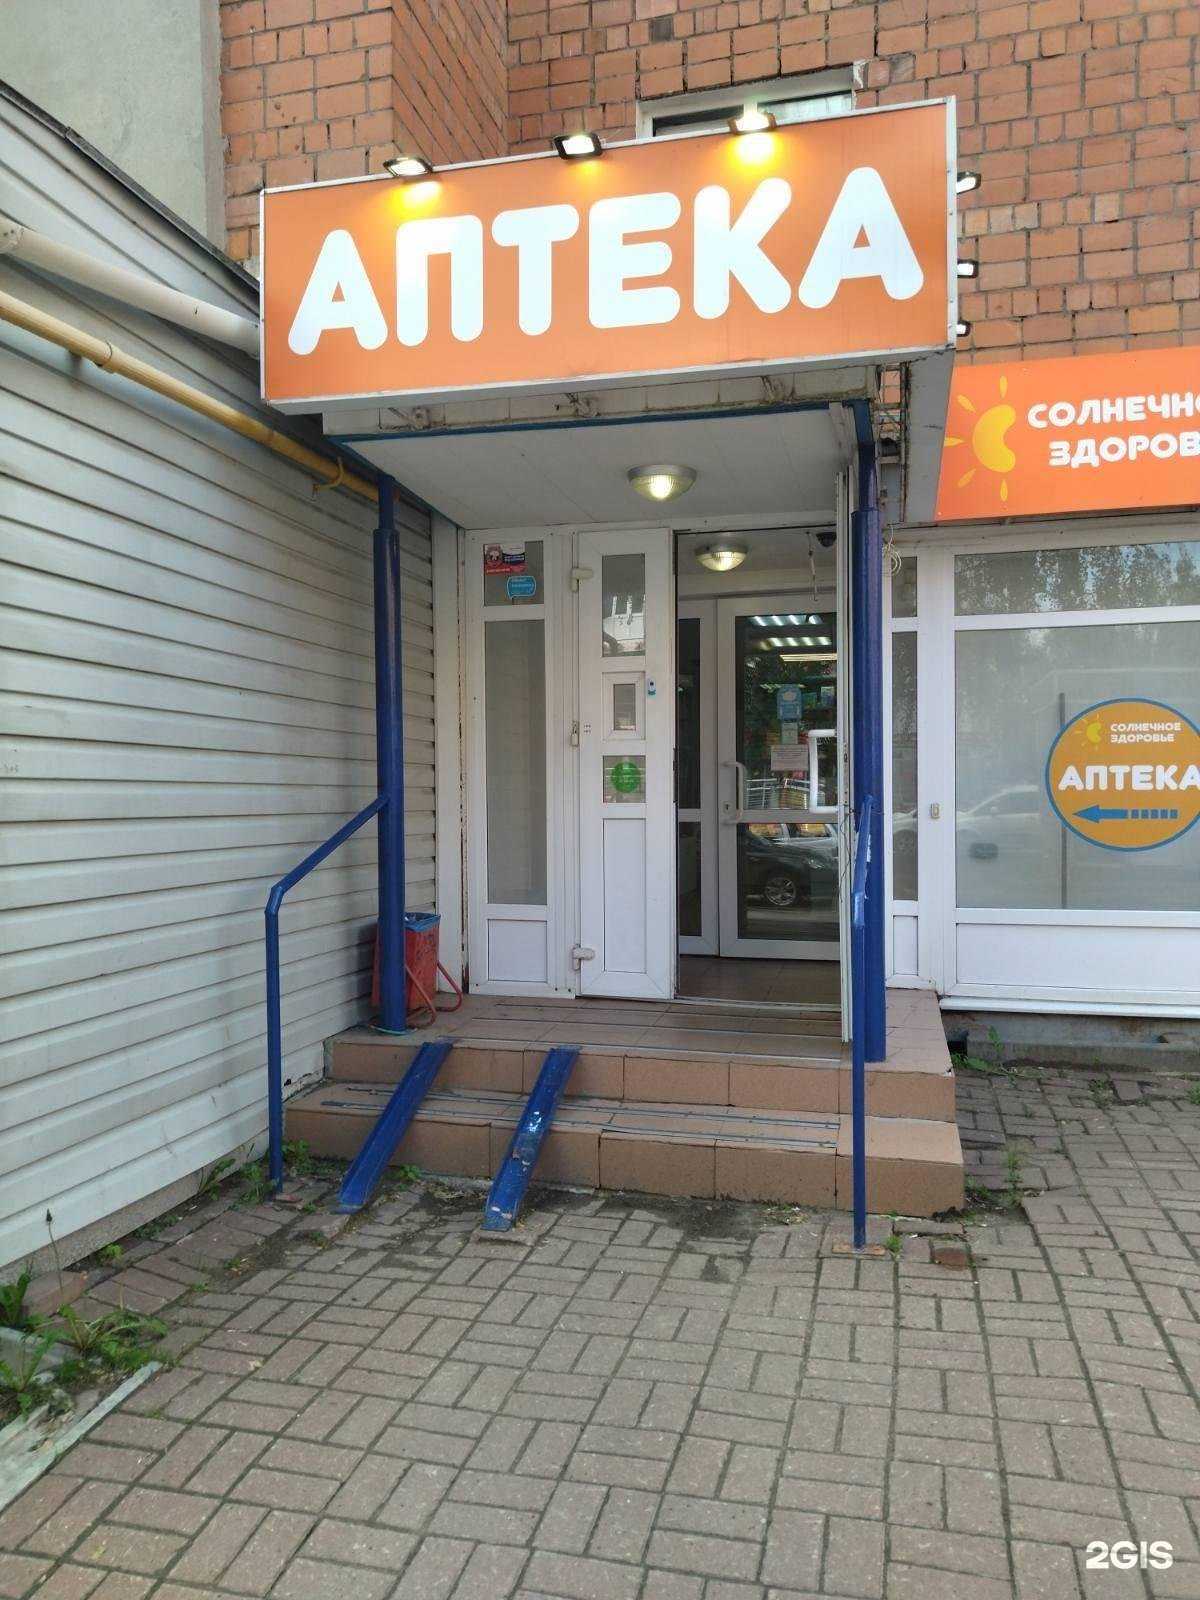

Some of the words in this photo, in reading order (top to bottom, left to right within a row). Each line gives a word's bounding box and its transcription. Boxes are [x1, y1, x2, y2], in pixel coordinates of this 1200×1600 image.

[288, 166, 924, 356] АПТЕКА
[1027, 391, 1200, 429] СОЛНЕЧН
[1110, 722, 1182, 733] СОЛНЕЧНОЕ
[1110, 734, 1175, 744] ЗДОРОВЬЕ
[1058, 765, 1200, 791] АПТЕКА
